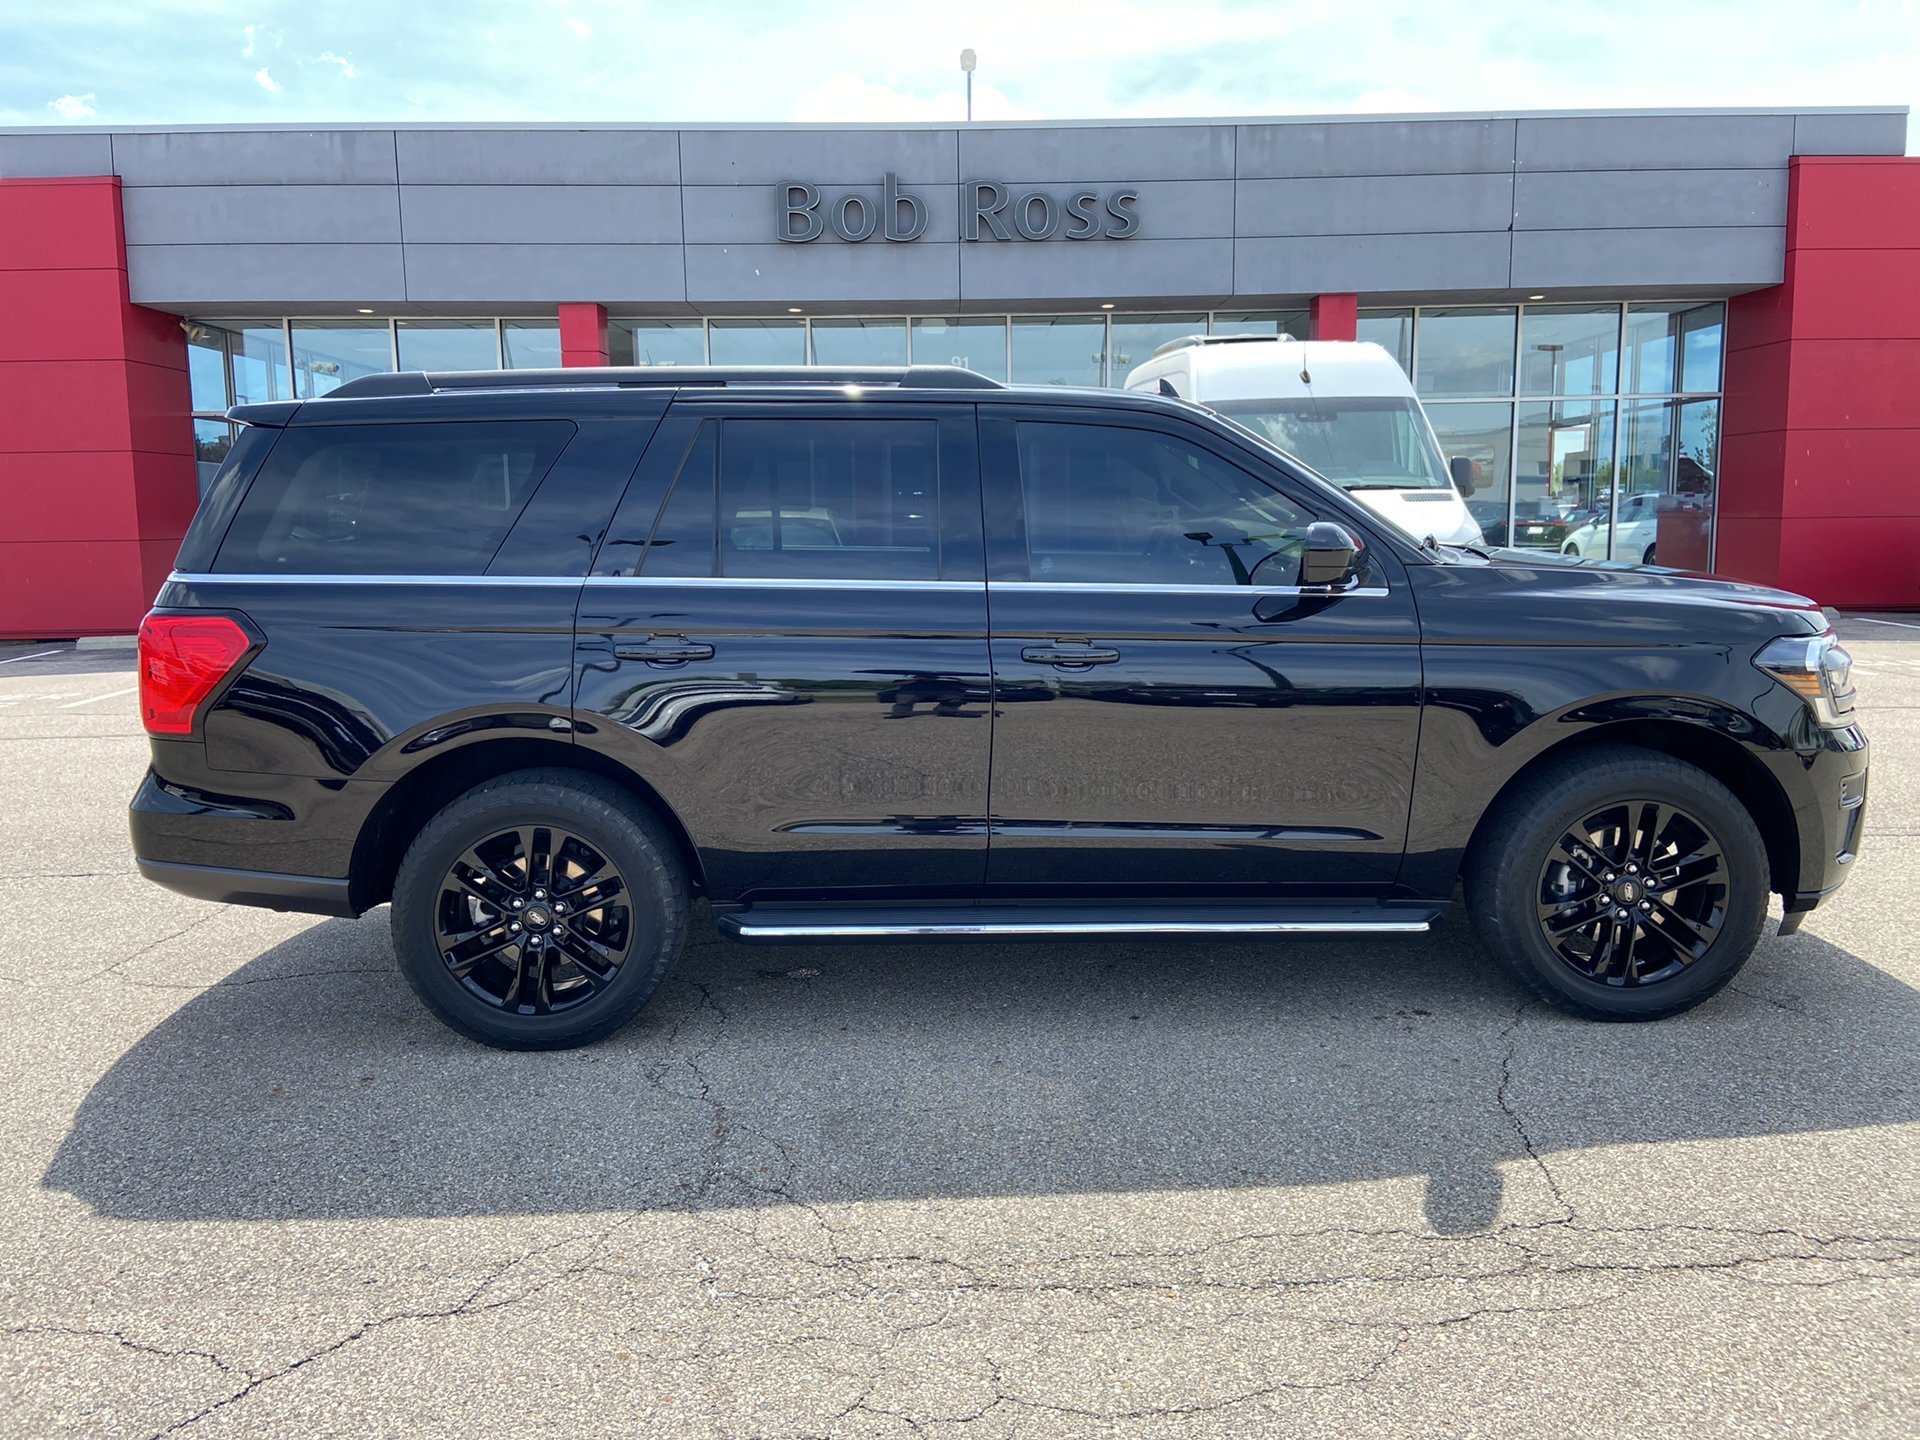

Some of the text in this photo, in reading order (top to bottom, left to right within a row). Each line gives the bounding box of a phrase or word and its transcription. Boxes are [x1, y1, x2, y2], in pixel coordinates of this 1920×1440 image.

[776, 172, 1141, 242] Bob Ross
[951, 355, 969, 369] 91
